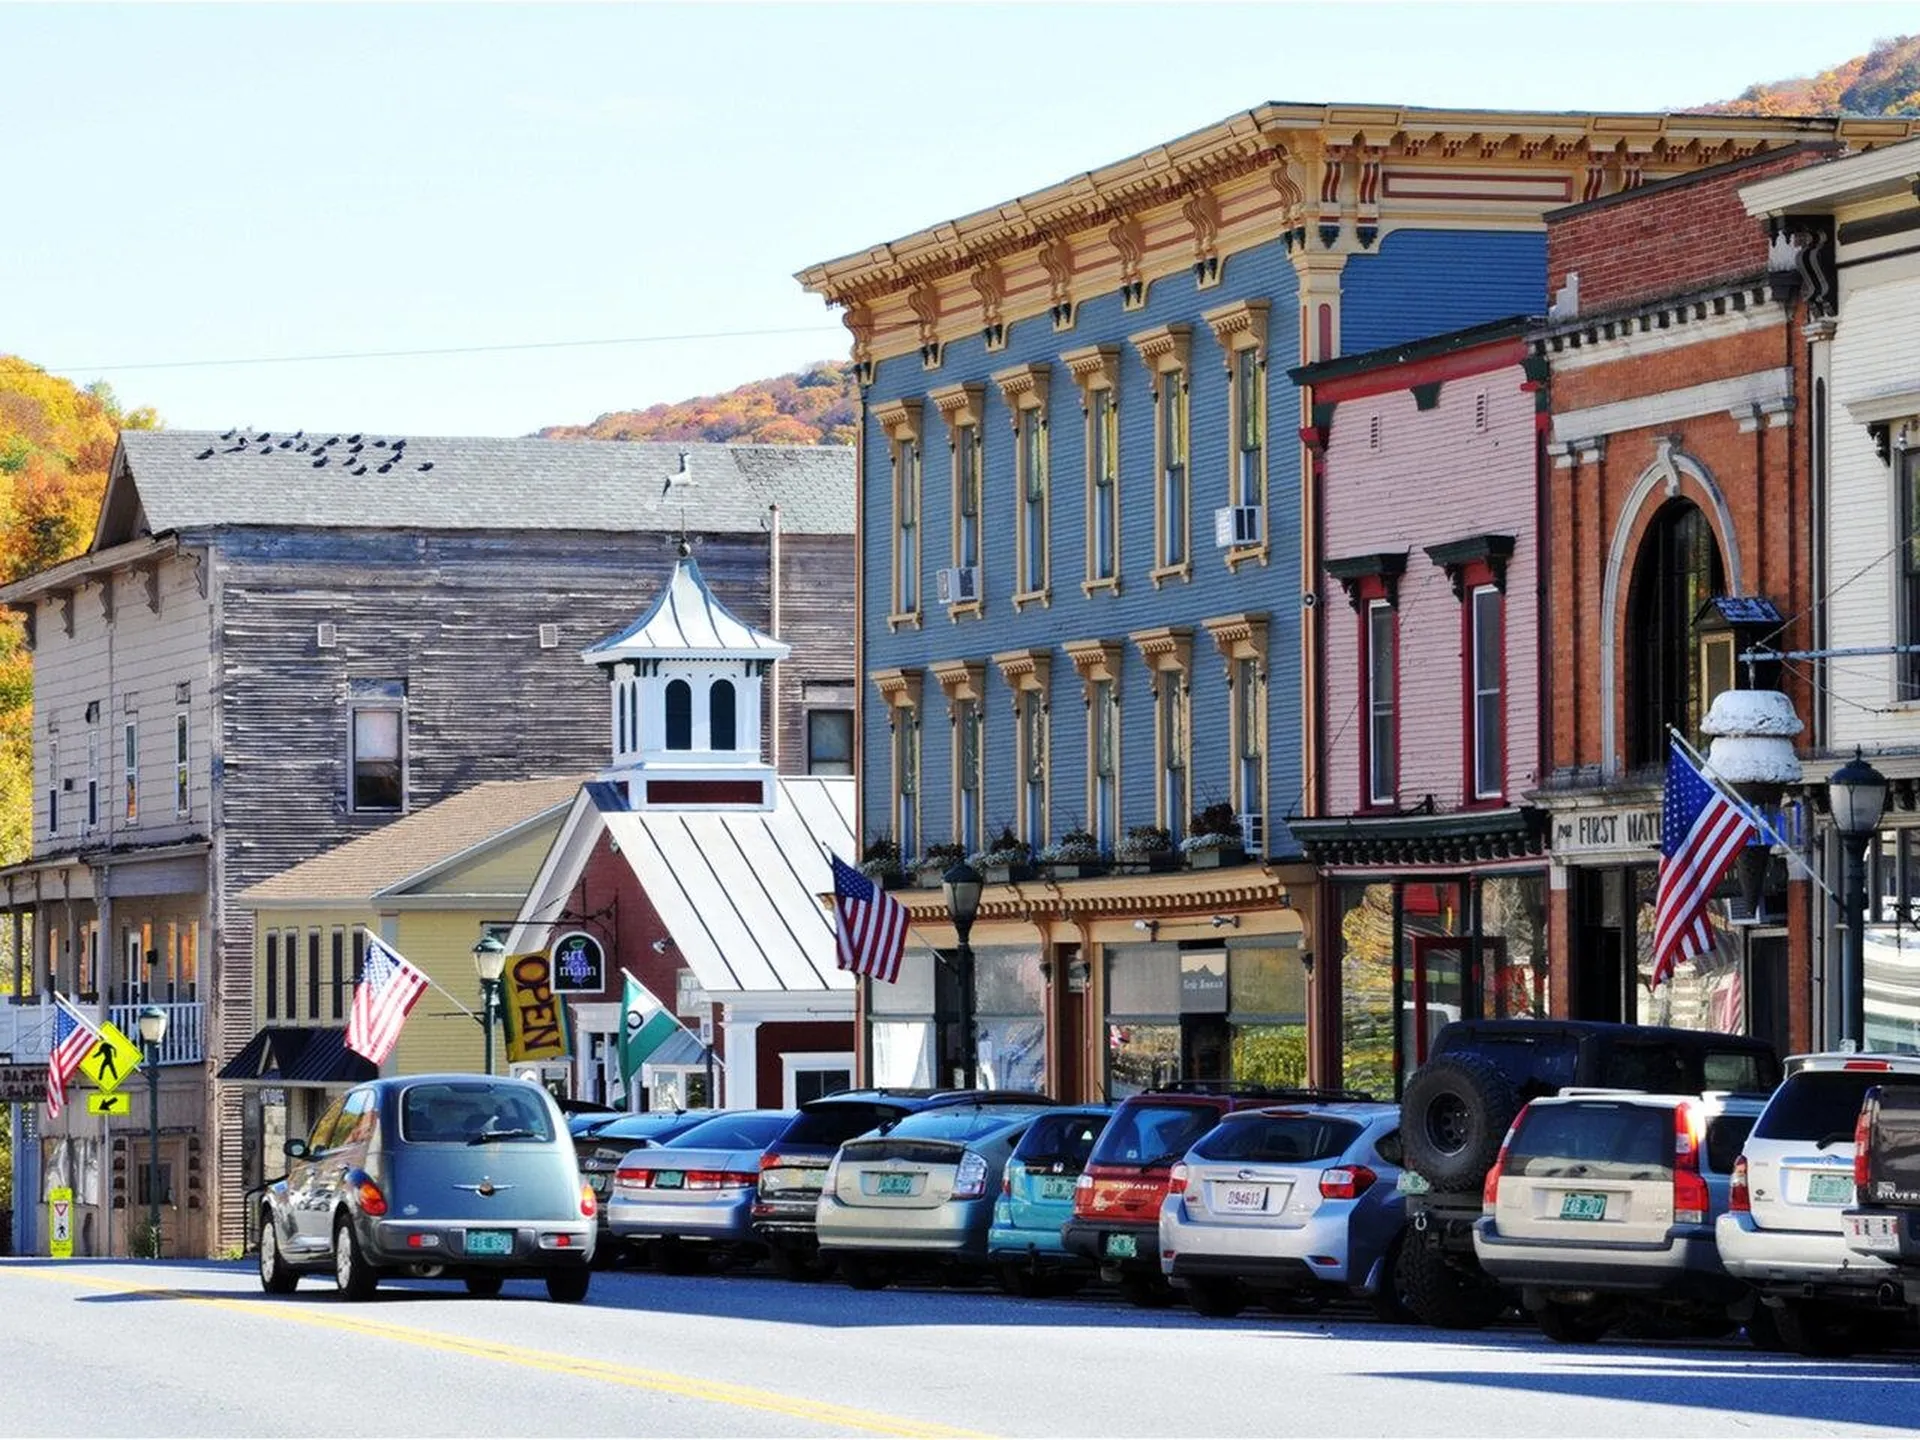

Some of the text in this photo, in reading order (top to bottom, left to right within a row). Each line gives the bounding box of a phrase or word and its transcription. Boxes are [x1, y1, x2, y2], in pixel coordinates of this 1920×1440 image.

[1579, 815, 1618, 845] FIRST
[1627, 811, 1661, 842] NATI
[561, 950, 583, 962] art
[559, 963, 597, 976] main
[513, 956, 561, 1052] OPEN
[1112, 1182, 1159, 1190] SUBARU
[1877, 1190, 1920, 1200] SILVER
